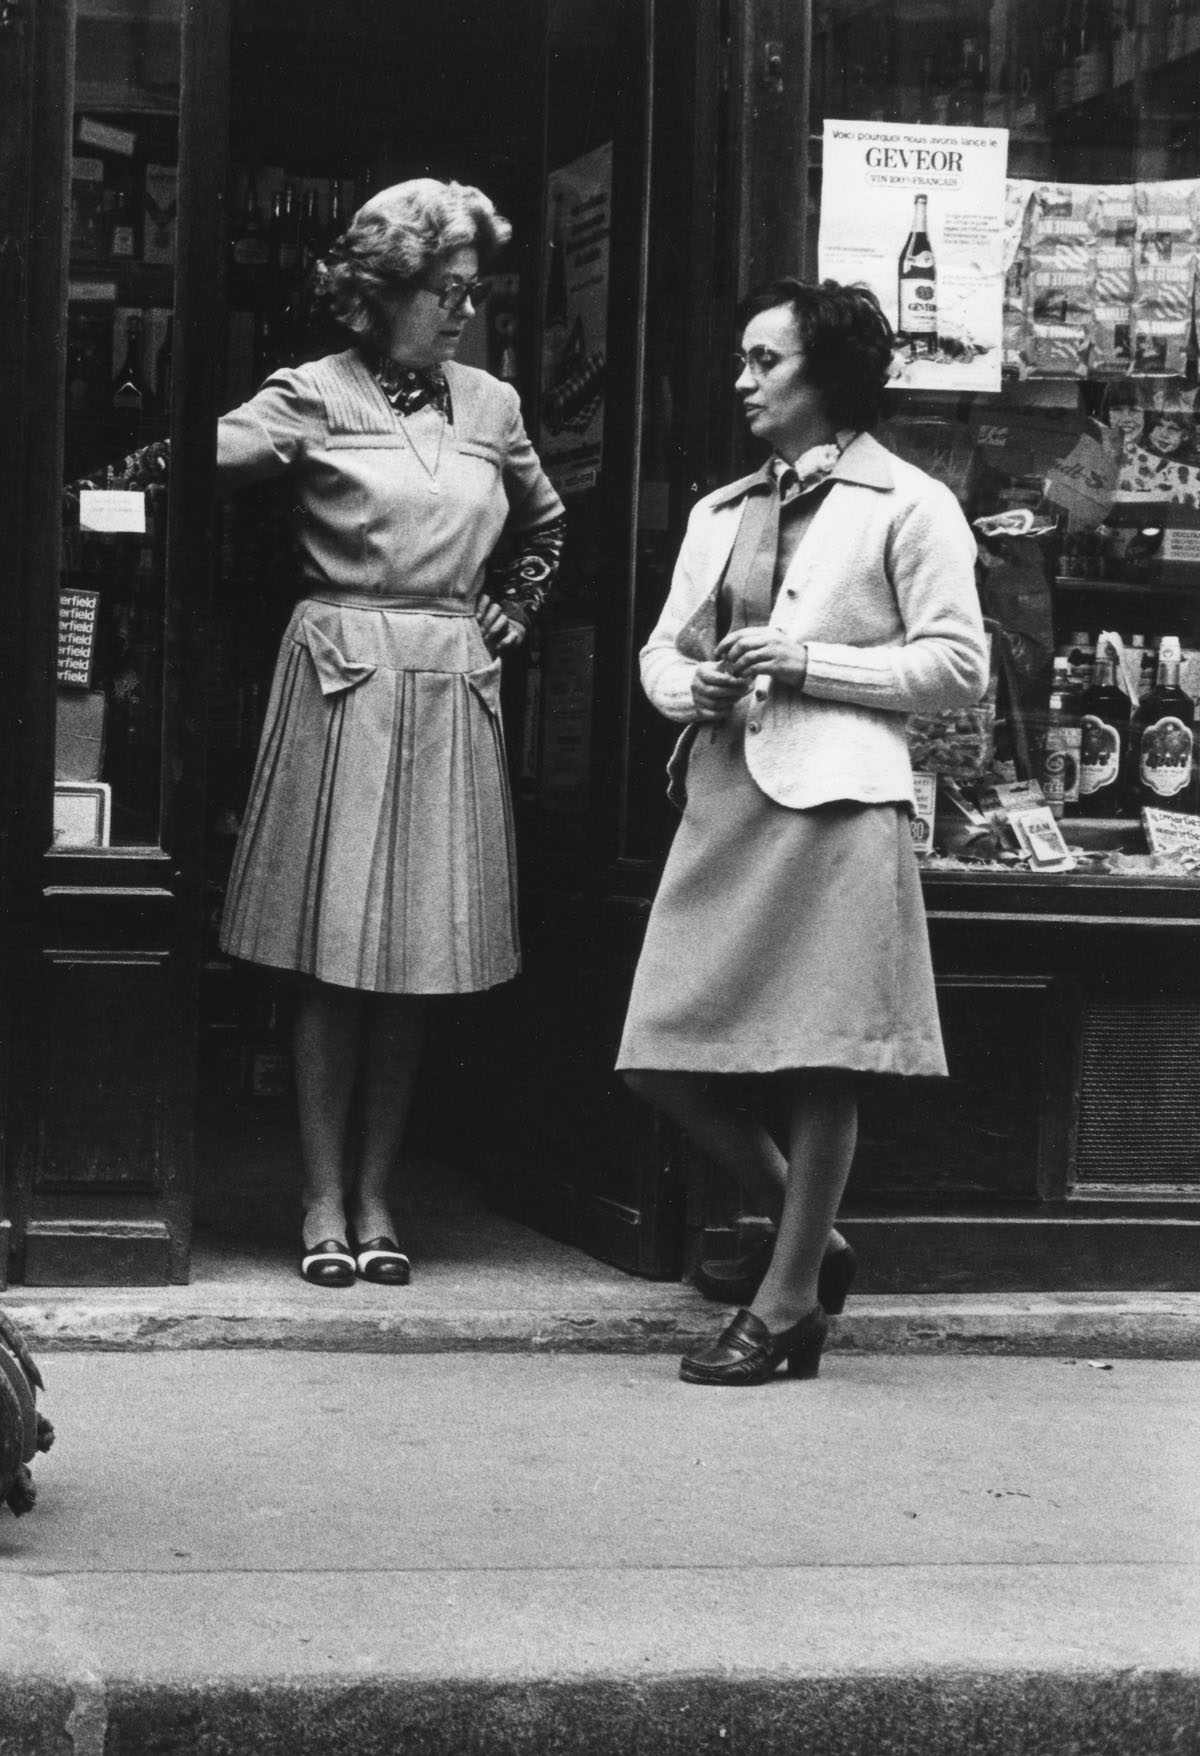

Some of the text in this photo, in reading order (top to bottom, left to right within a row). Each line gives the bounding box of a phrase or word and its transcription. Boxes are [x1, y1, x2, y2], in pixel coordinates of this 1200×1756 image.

[858, 131, 900, 142] pourquoi
[903, 135, 927, 144] nous
[865, 147, 964, 172] GEVEOR
